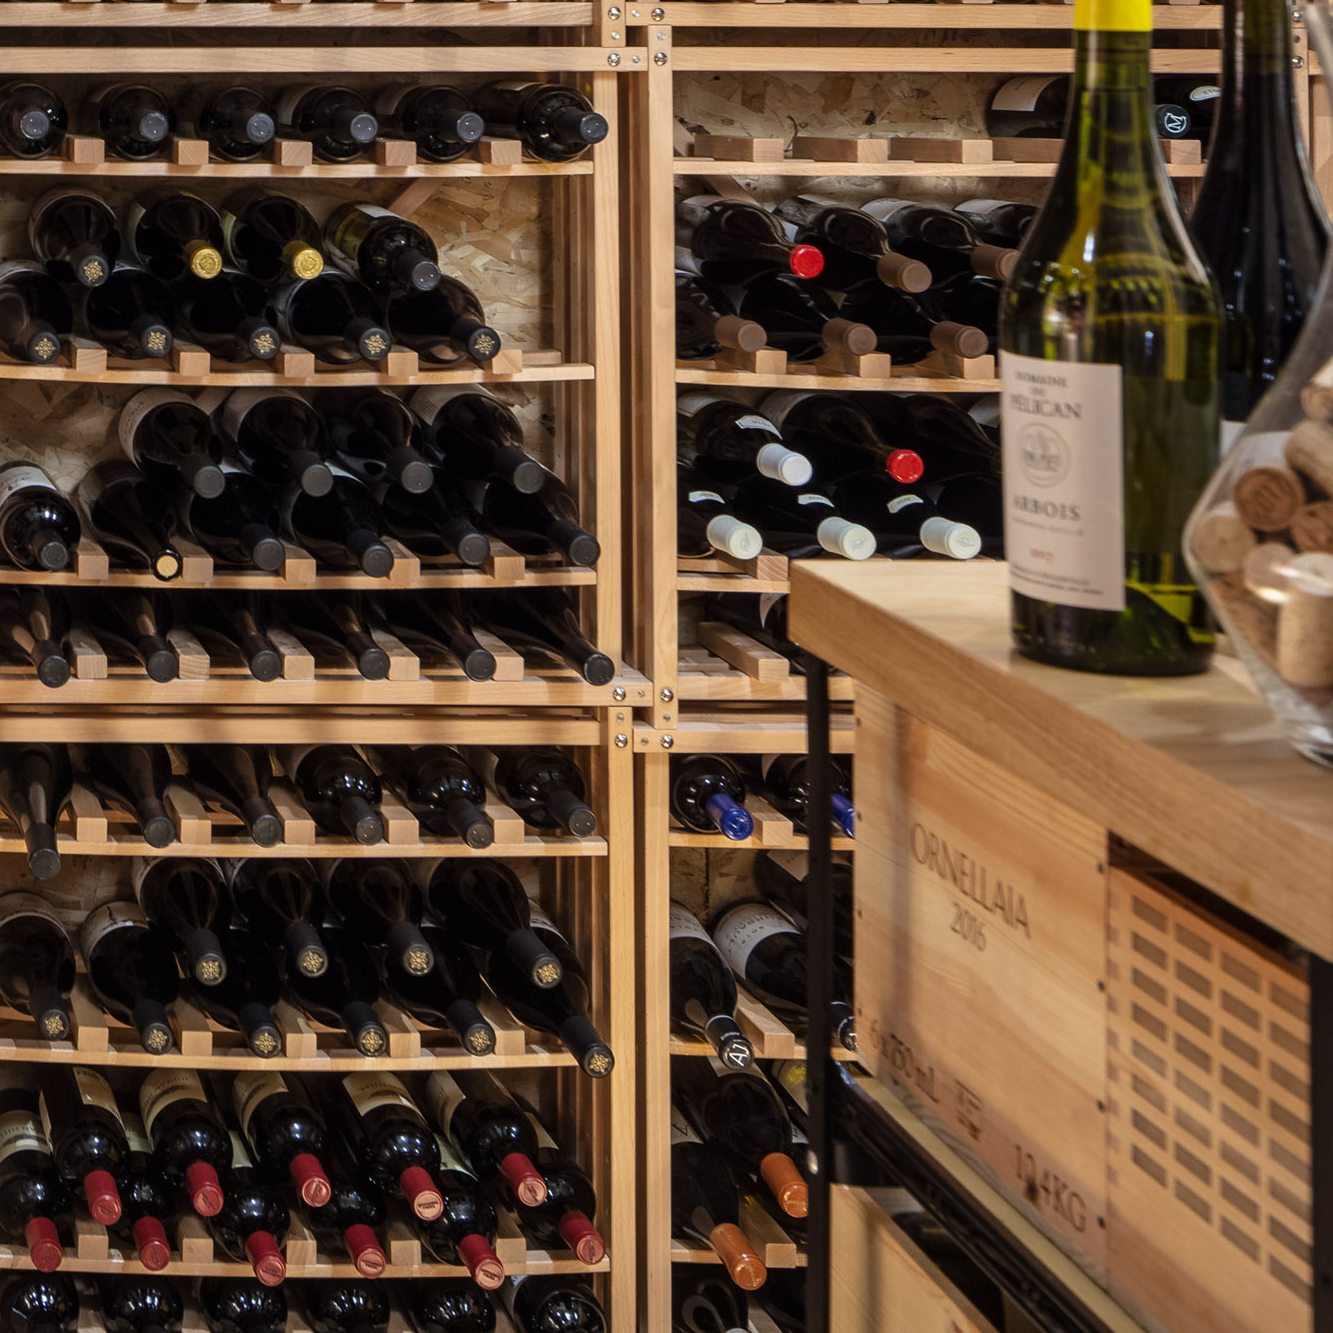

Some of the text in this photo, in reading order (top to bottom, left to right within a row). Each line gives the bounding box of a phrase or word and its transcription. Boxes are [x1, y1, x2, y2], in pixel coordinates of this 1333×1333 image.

[1015, 370, 1068, 388] DOMAINE
[1014, 494, 1081, 521] ARBOIS
[910, 822, 1031, 939] ORNELLAIA
[950, 901, 987, 952] 2016
